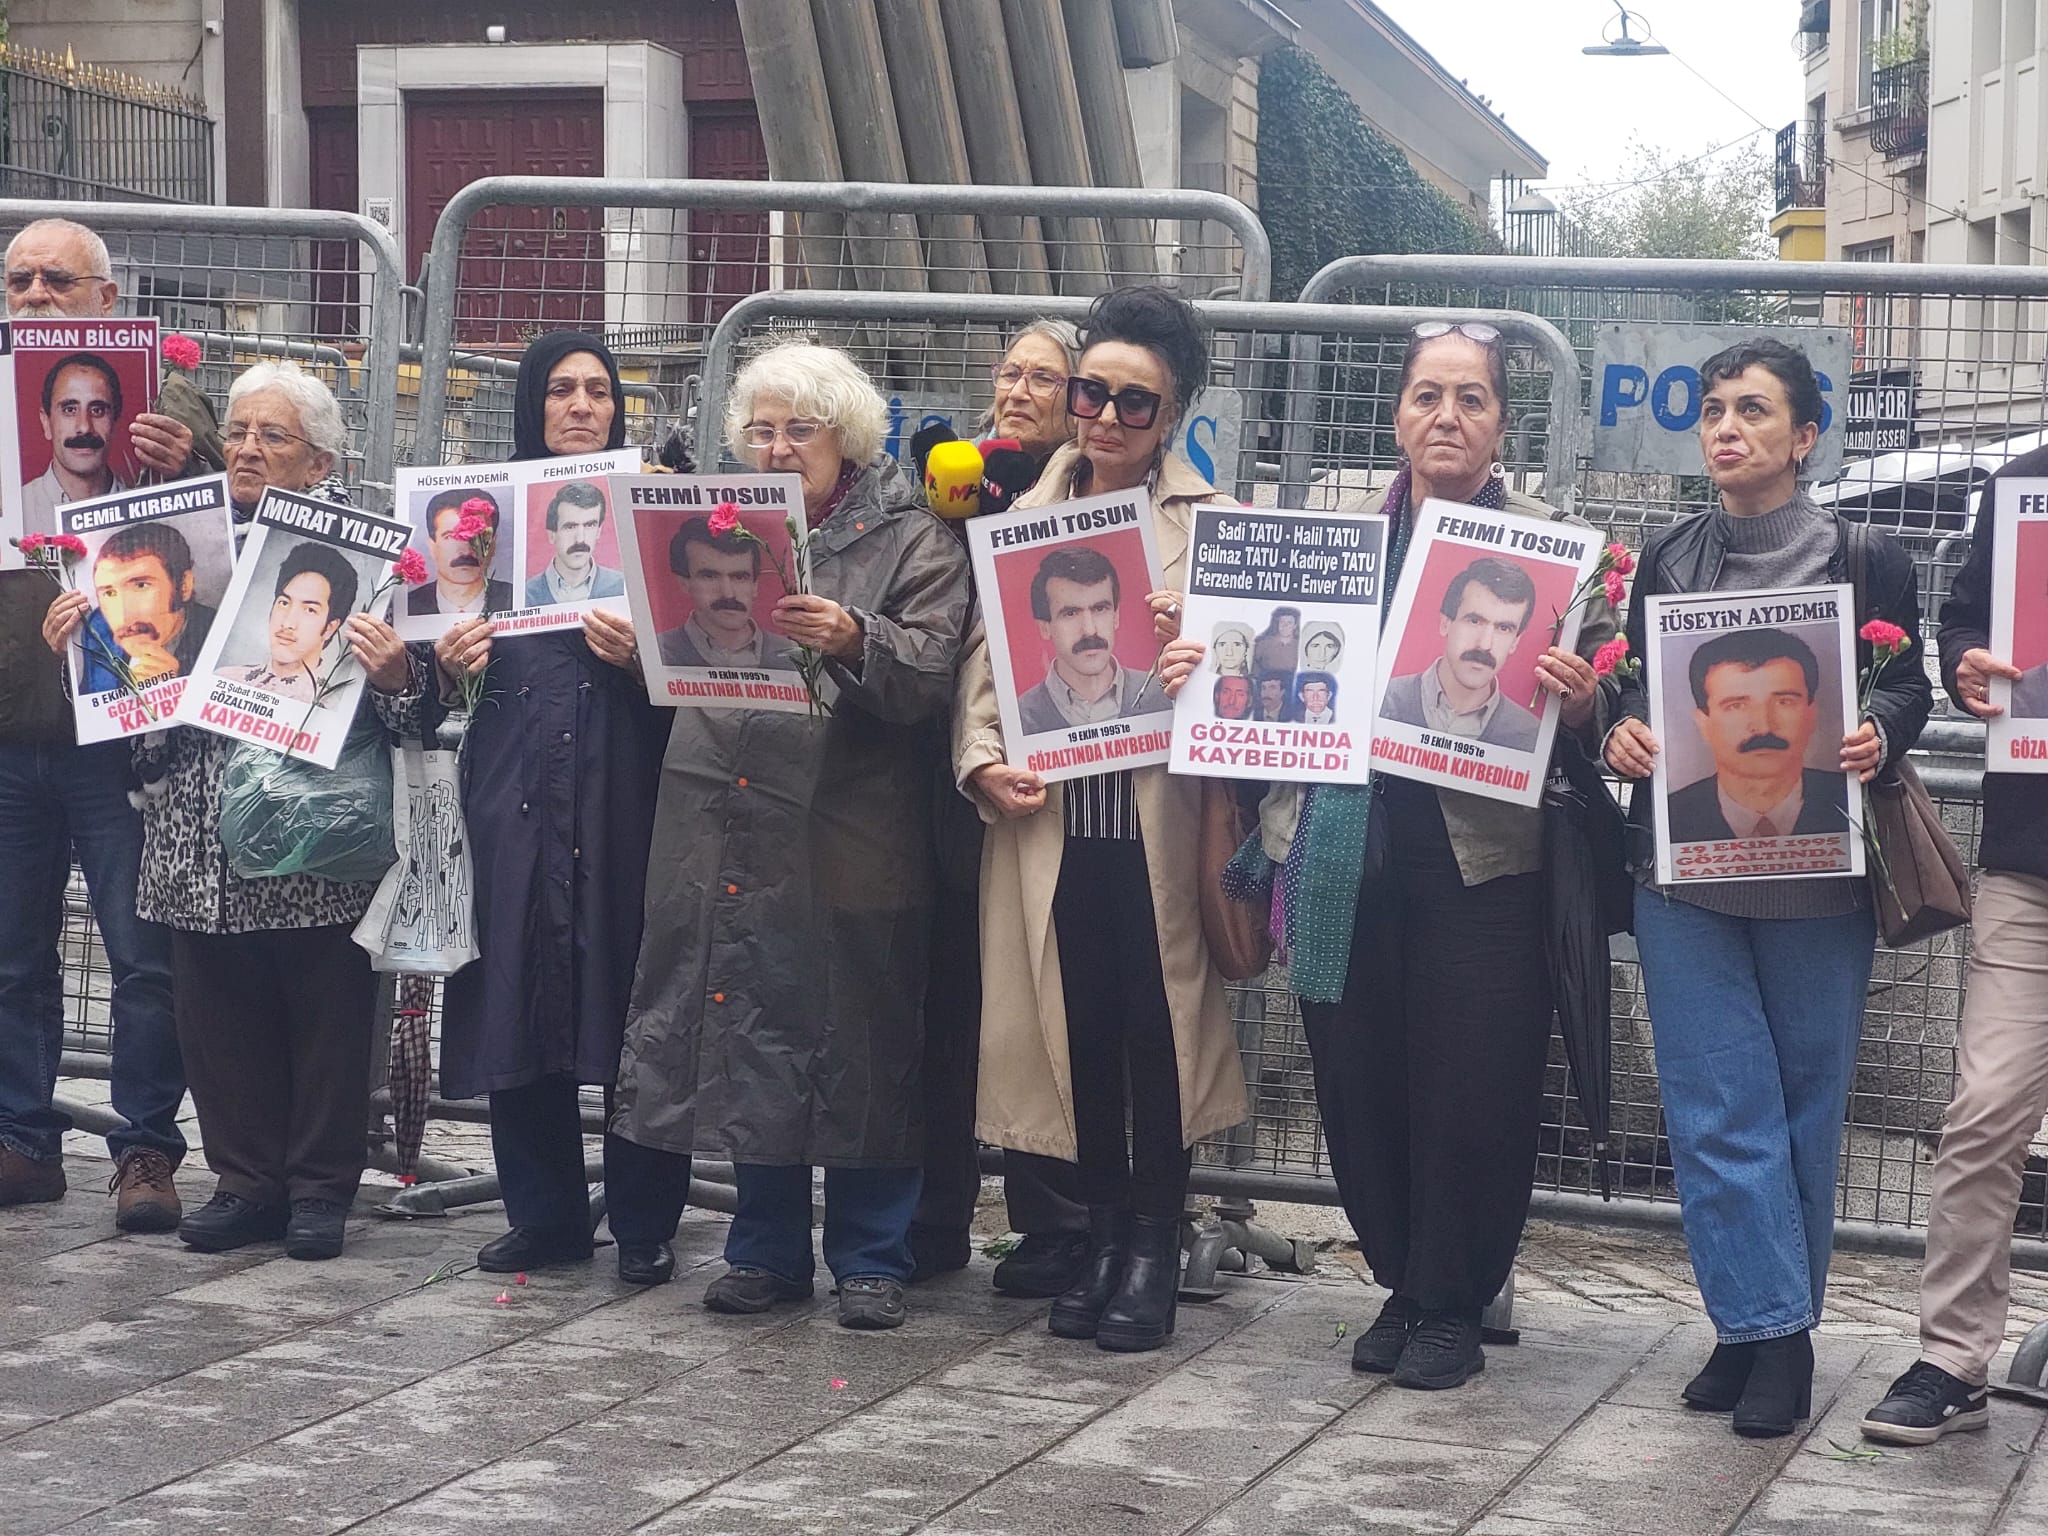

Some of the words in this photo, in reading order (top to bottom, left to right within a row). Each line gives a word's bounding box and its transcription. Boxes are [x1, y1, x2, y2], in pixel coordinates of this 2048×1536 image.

[13, 329, 79, 347] KENAN
[85, 323, 153, 347] BİLGİN
[417, 473, 462, 486] HÜSEYİN
[464, 470, 509, 485] AYDEMİR
[543, 464, 577, 478] FEHMİ
[579, 460, 615, 474] TOSUN
[128, 488, 215, 519] KIRBAYIR
[630, 485, 702, 504] FEHMİ
[705, 487, 787, 504] TOSUN
[262, 496, 338, 535] MURAT
[339, 517, 407, 555] YILDIZ
[990, 516, 1059, 549] FEHMİ
[1061, 502, 1138, 534] TOSUN
[1217, 520, 1246, 541] Sadi
[1249, 522, 1283, 544] TATU
[1293, 525, 1323, 546] Halil
[1326, 527, 1361, 548] TATU
[1436, 515, 1506, 545] FEHMİ
[1510, 528, 1586, 561] TOSUN
[1198, 542, 1242, 566] Gülnaz
[1245, 546, 1279, 568] TATU
[1289, 549, 1338, 576] Kadriye
[1341, 551, 1376, 573] TATU
[1195, 566, 1253, 590] Ferzende
[1256, 571, 1291, 593] TATU
[1301, 574, 1338, 595] Enver
[1340, 575, 1375, 597] TATU
[512, 611, 579, 630] KAYBEDİLDİLER
[667, 678, 744, 698] GÖZALTINDA
[707, 670, 717, 679] 19
[719, 669, 739, 681] EKİM
[91, 697, 100, 708] 8
[209, 690, 274, 719] GÖZALTINDA
[215, 679, 227, 689] 23
[227, 682, 250, 697] Şubat
[252, 690, 280, 706] 1995'te
[200, 702, 321, 754] KAYBEDİLDİ
[1067, 732, 1078, 743] 19
[1079, 727, 1099, 741] EKİM
[1099, 723, 1131, 737] 1995'te
[1190, 721, 1353, 750] GÖZALTINDA
[1027, 743, 1104, 773] GÖZALTINDA
[1420, 733, 1430, 745] 19
[1430, 734, 1452, 750] EKİM
[1453, 740, 1486, 758] 1995'te
[1370, 736, 1448, 773] GÖZALTINDA
[1450, 757, 1531, 792] KAYBEDİLDİ
[1675, 847, 1846, 866] GÖZALTINDA
[1680, 845, 1706, 854] 19
[1784, 836, 1841, 847] 1995
